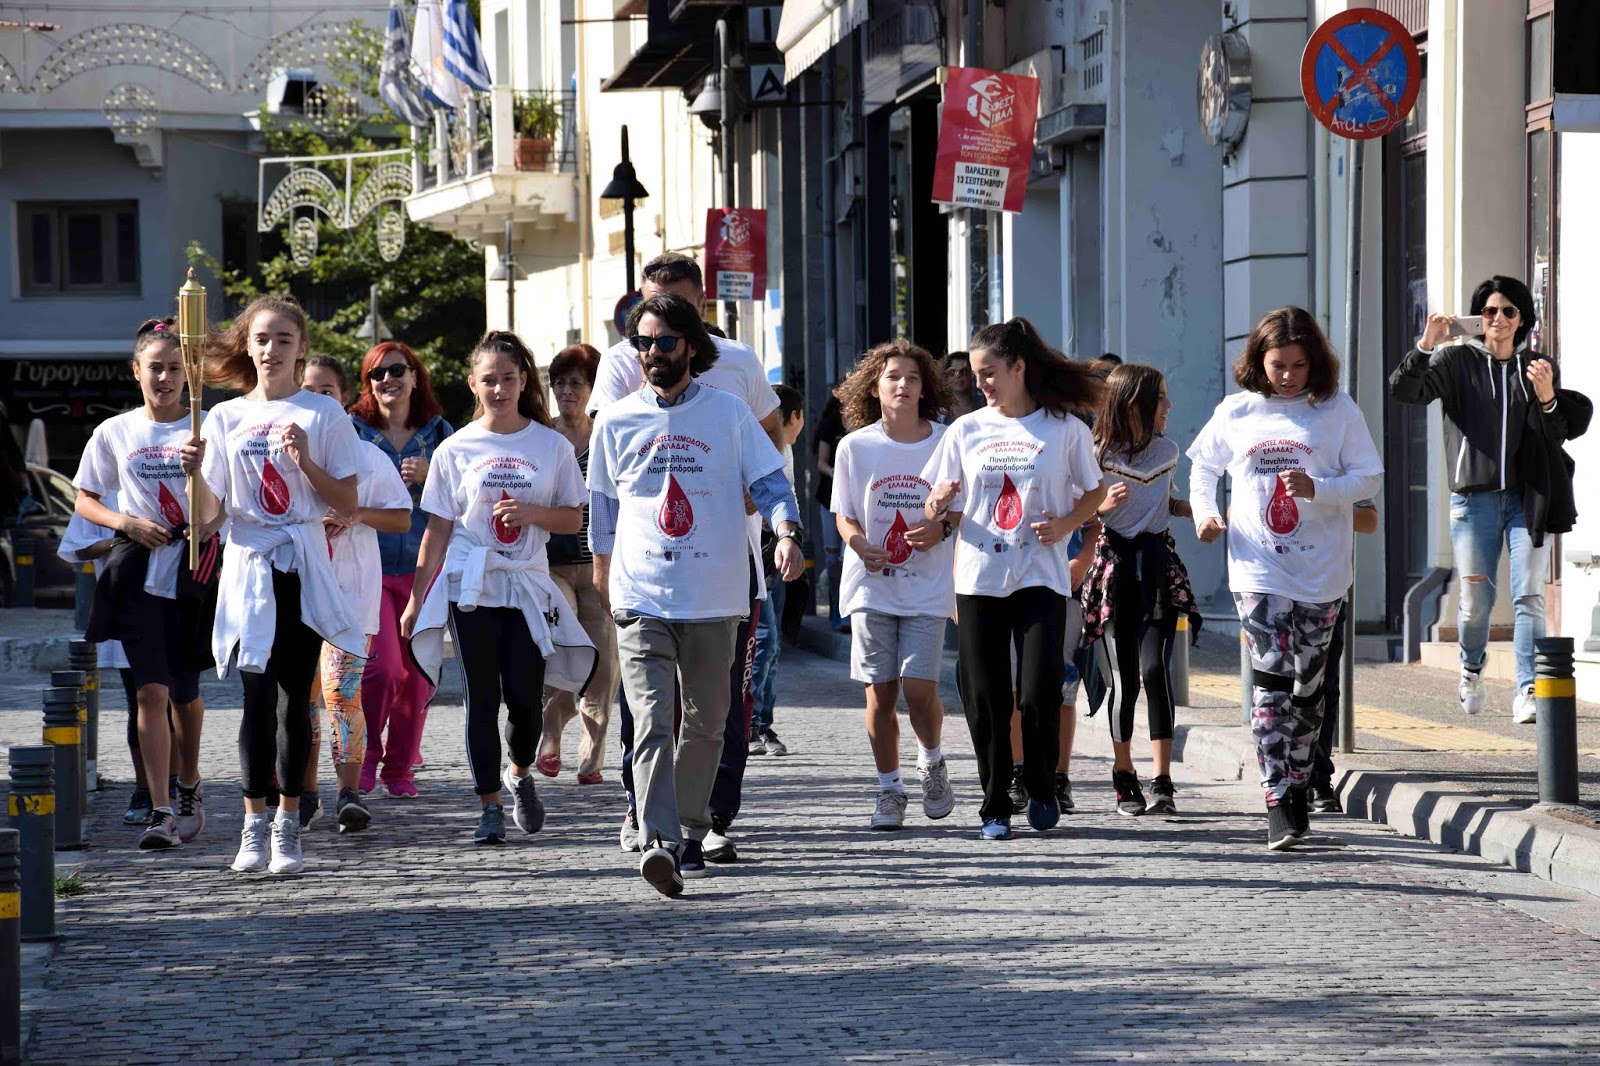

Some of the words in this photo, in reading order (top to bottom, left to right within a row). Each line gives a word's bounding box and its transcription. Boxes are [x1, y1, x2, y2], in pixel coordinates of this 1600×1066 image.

[965, 165, 1001, 177] ΠΑΡΑΣΚΕΥΗ
[957, 175, 964, 184] 13
[965, 176, 1005, 189] ΣΕΠΤΕΜΒΡΙΟΥ
[638, 434, 671, 457] ΕΘΕΛΟΝΤΕΣ
[673, 435, 711, 454] ΑΙΜΟΔΟΤΕΣ
[657, 443, 690, 452] ΕΛΛΑΔΑΣ
[977, 441, 1010, 456] ΕΘΕΛΟΝΤΕΣ
[1278, 439, 1313, 456] ΑΙΜΟΔΟΤΕΣ
[1262, 447, 1294, 455] ΕΛΛΑΔΑΣ
[653, 455, 695, 464] Πανελλήνια
[1260, 457, 1299, 465] Πανελλήνια
[141, 463, 180, 471] Πανελλήνια
[473, 457, 504, 473] ΕΘΕΛΟΝΤΕΣ
[505, 456, 539, 472] ΑΙΜΟΔΟΤΕΣ
[981, 463, 1035, 473] Λαμπαδηδρομία
[647, 464, 703, 475] Λαμπαδηδρομία
[488, 472, 525, 480] Πανελλήνια
[482, 480, 532, 489] Λαμπαδηδρομία
[871, 475, 902, 491] ΕΘΕΛΟΝΤΕΣ
[888, 482, 917, 490] ΕΛΛΑΔΑΣ
[883, 492, 920, 500] Πανελλήνια
